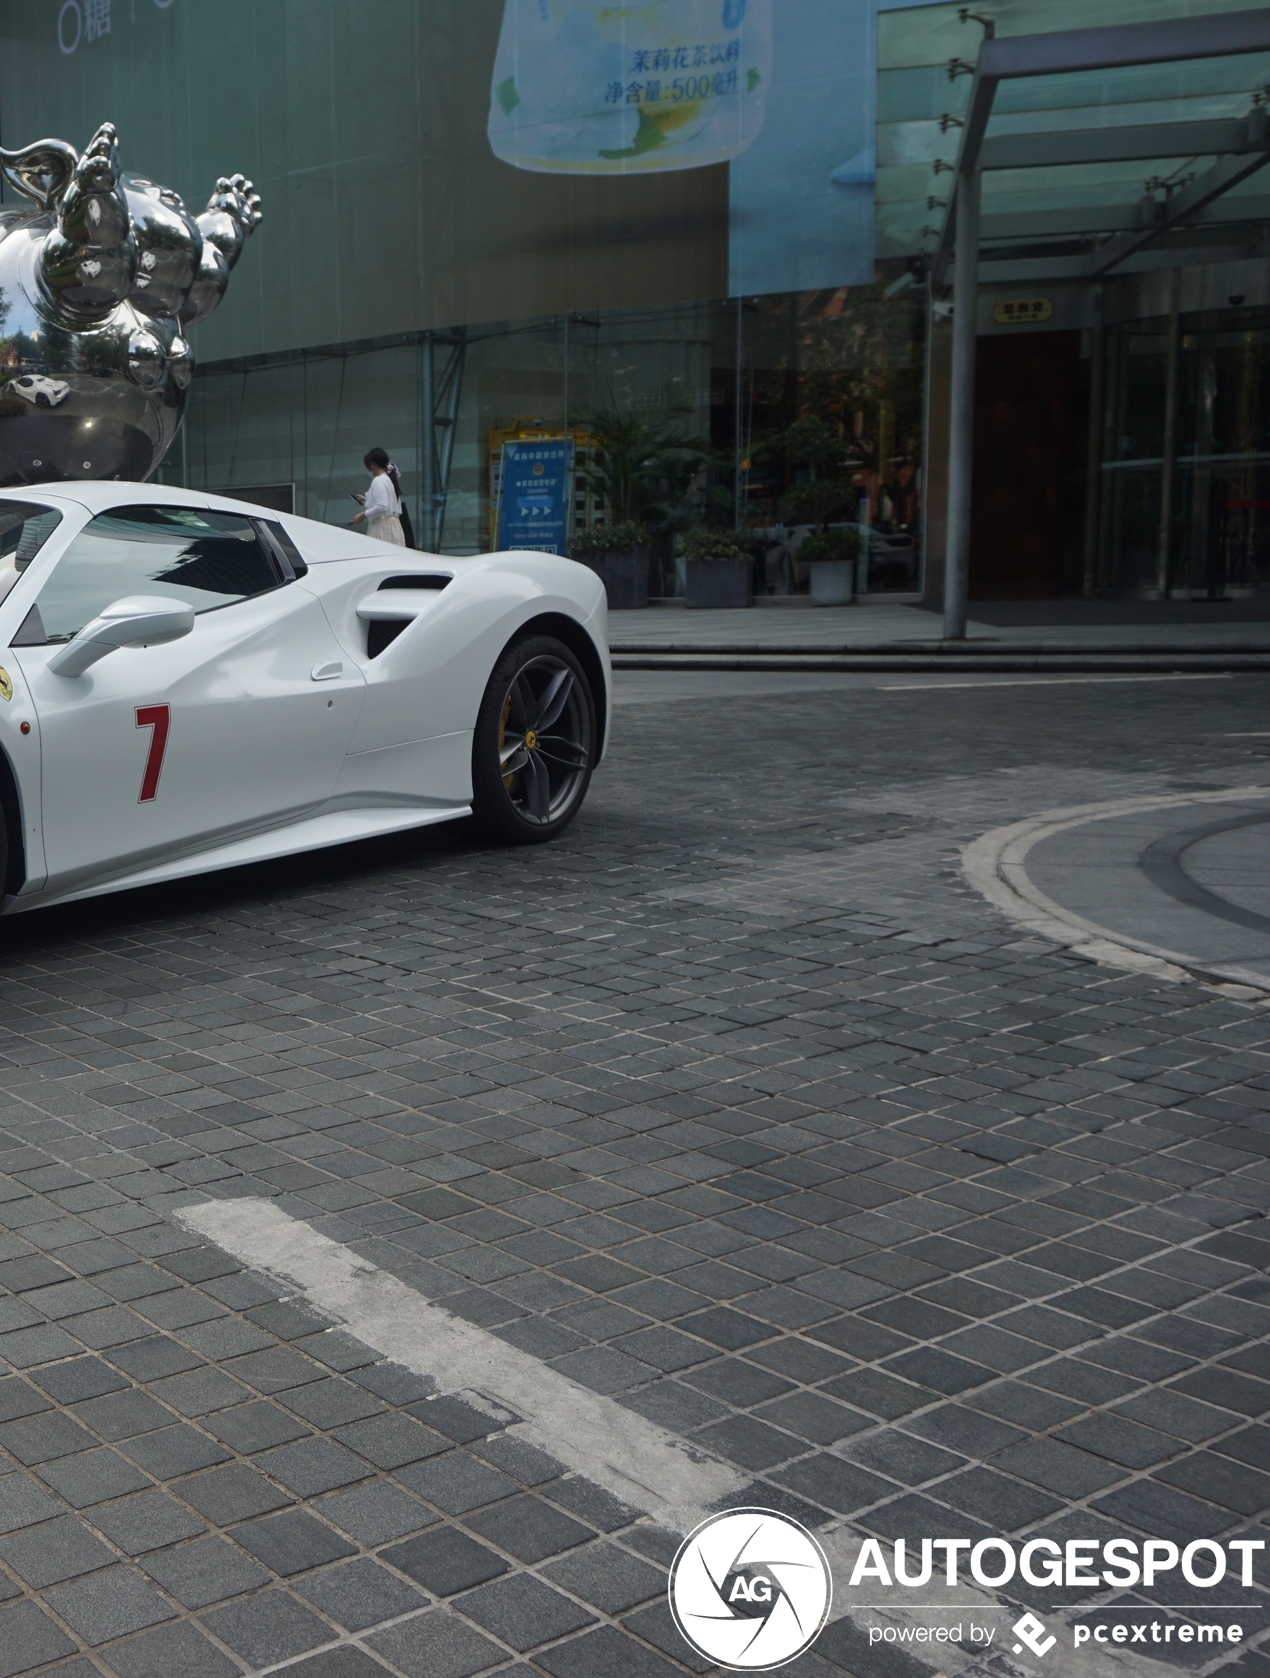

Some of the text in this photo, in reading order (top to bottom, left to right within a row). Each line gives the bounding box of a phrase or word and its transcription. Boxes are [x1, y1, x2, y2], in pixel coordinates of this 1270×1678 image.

[630, 39, 741, 73] 茉莉花茶饮料
[134, 702, 171, 804] 7
